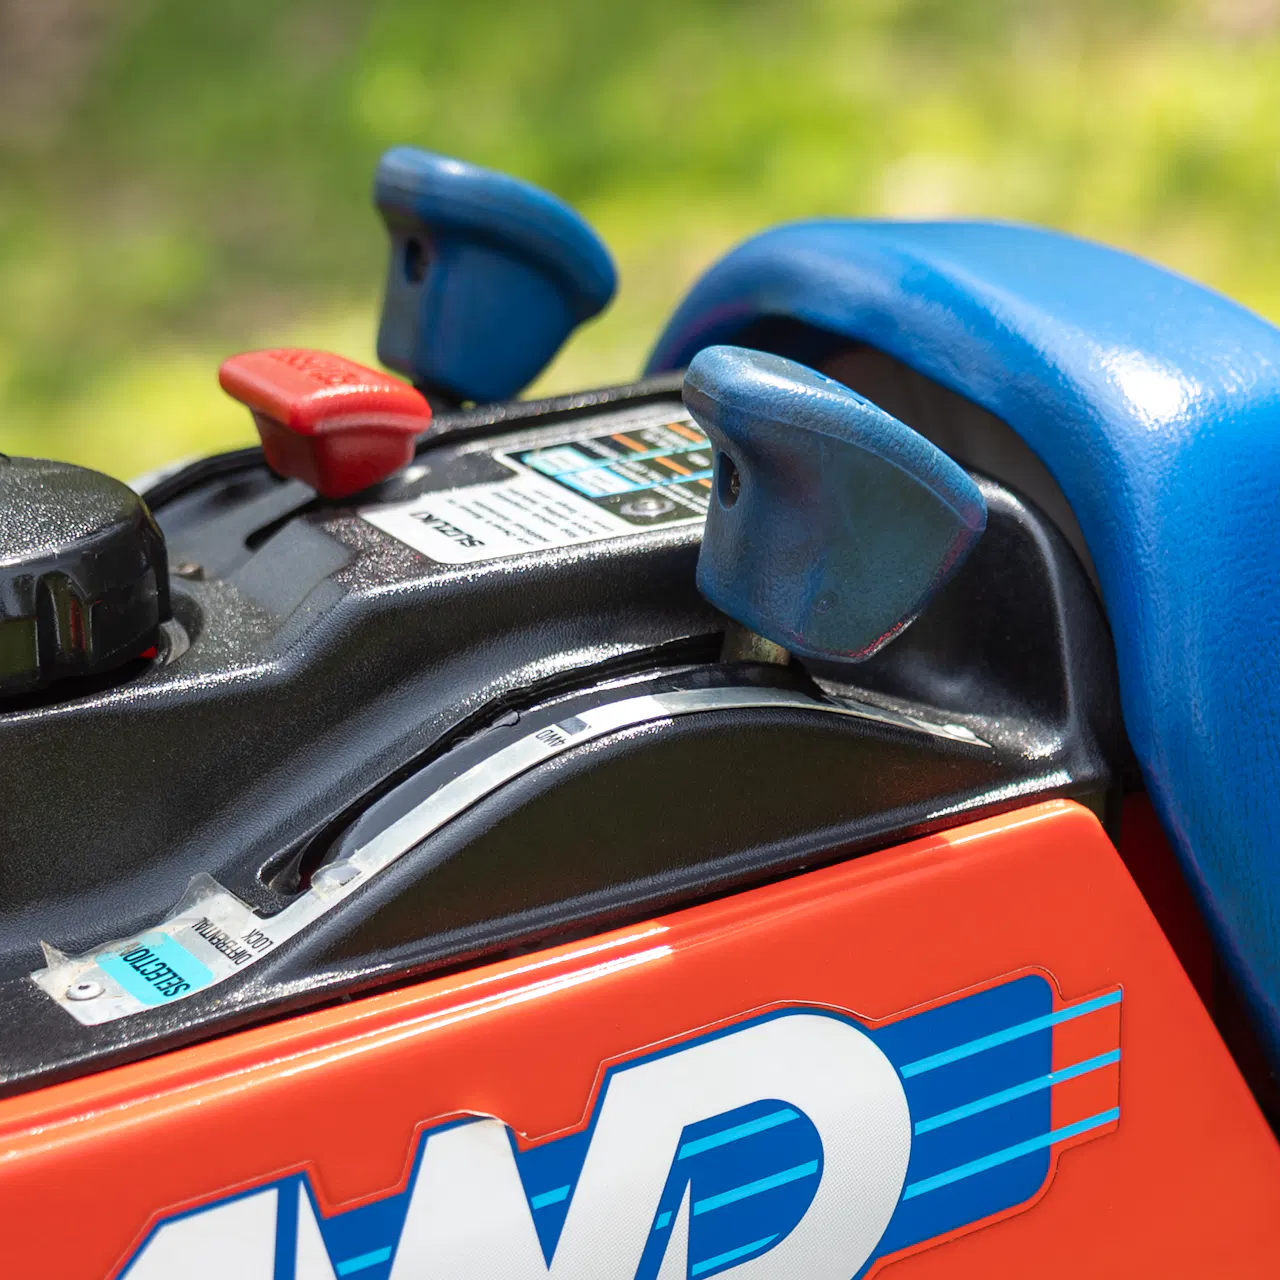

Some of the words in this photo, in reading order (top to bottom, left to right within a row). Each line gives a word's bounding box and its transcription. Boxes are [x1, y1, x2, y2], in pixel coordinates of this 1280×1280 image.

[409, 511, 486, 549] SUZUKI
[535, 729, 567, 747] 4WD
[191, 916, 255, 966] DIFFERENTIAL
[241, 928, 274, 953] LOCK
